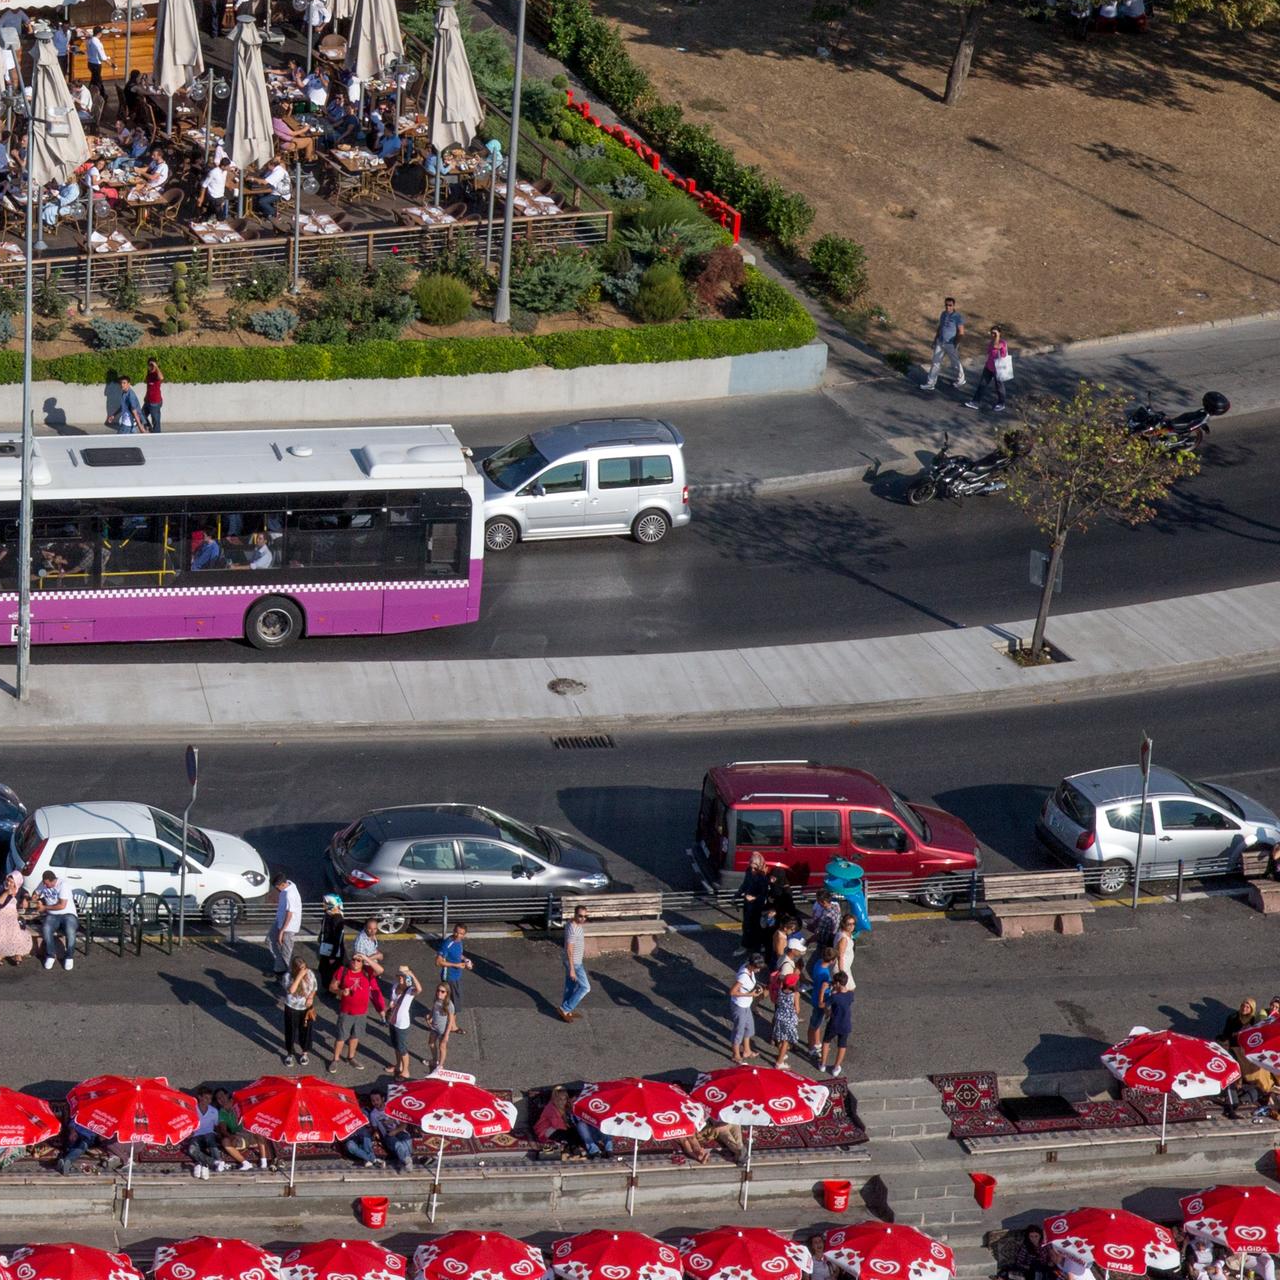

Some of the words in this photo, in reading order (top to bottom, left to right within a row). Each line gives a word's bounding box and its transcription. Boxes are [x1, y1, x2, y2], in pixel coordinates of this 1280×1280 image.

[780, 1115, 803, 1124] ALGIDA
[662, 1129, 687, 1138] ALGIDA
[1237, 1245, 1268, 1253] ALGIDA
